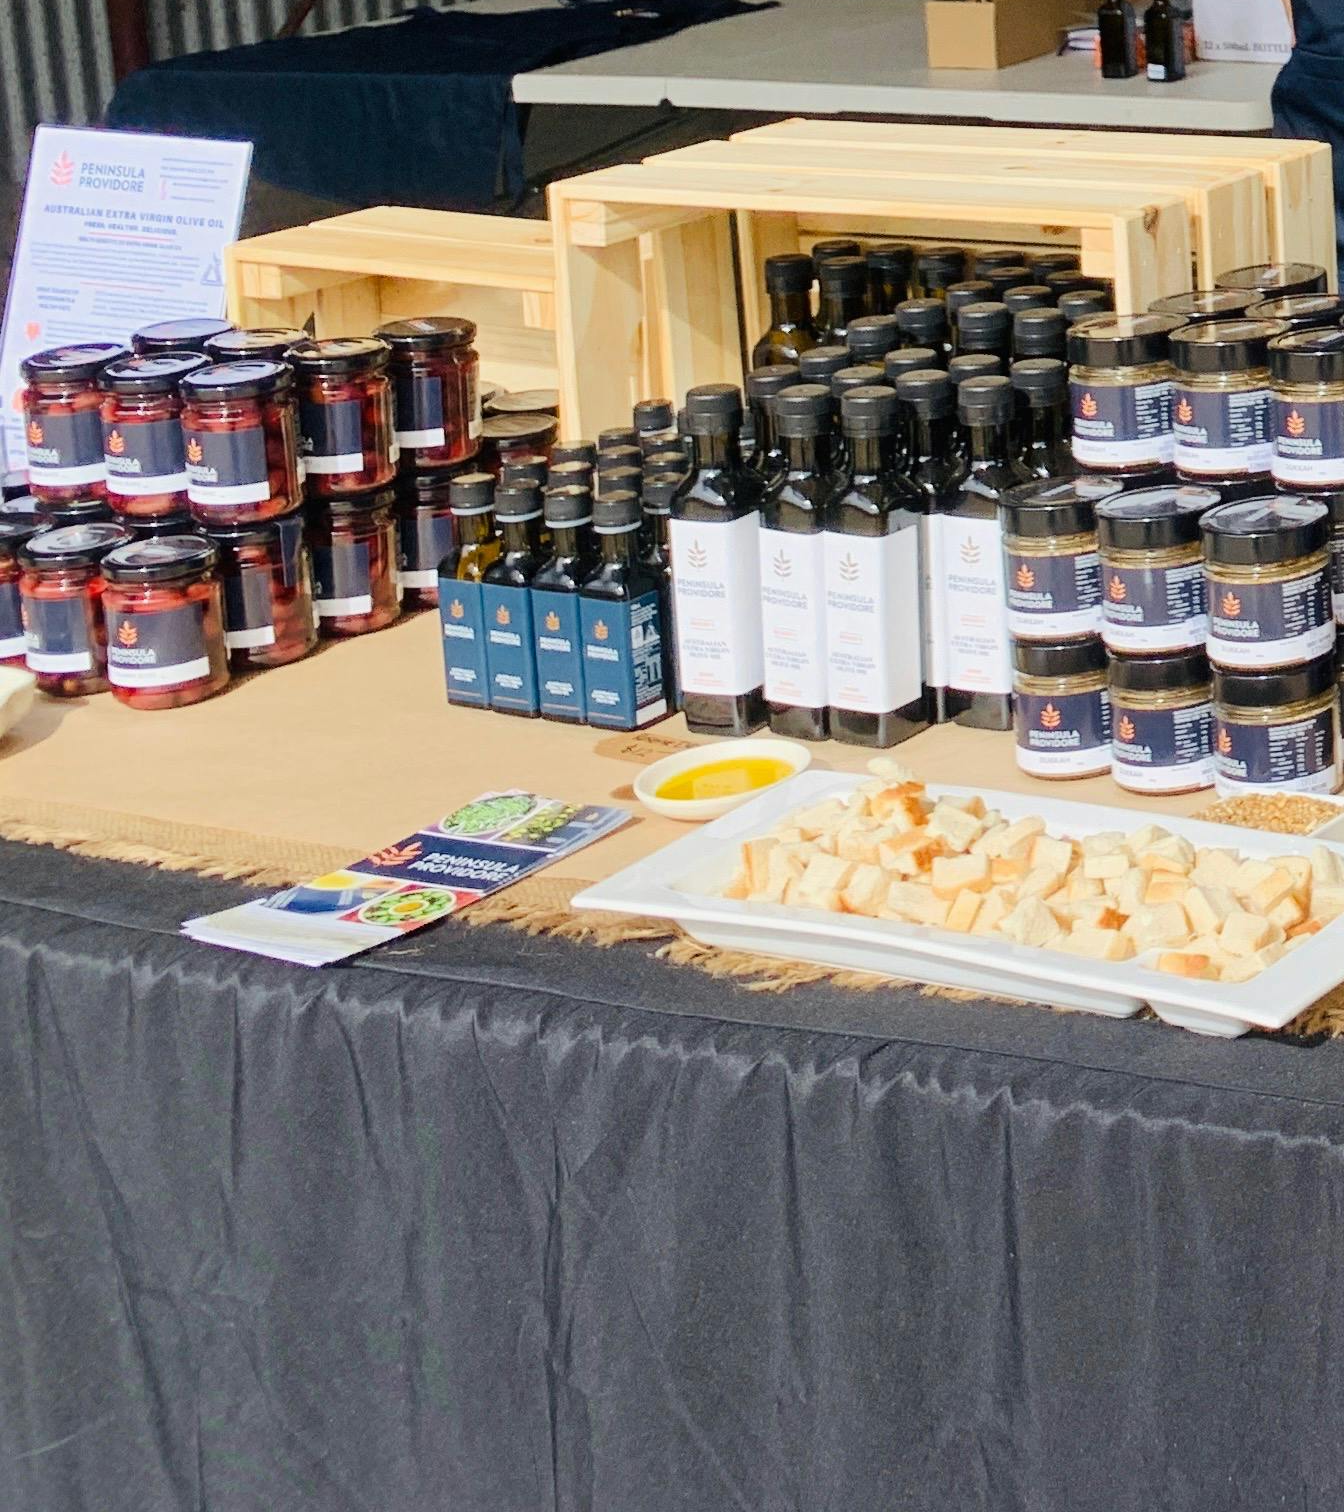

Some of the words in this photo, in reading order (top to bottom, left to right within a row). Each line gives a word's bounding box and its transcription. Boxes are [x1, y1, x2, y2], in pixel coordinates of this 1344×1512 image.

[81, 162, 145, 178] PENINSULA
[79, 176, 144, 193] PROVIDORE
[44, 204, 103, 217] AUSTRALIAN
[105, 210, 136, 220] EXTRA
[139, 213, 173, 223] VIRGIN
[176, 216, 204, 227] OLIVE
[208, 219, 224, 229] OIL
[678, 578, 725, 589] PENINSULA
[949, 575, 996, 585] PENINSULA
[677, 587, 725, 598] PROVIDORE
[762, 587, 807, 600] PENINSULA
[949, 583, 997, 595] PROVIDORE
[762, 595, 808, 609] PROVIDORE
[828, 590, 875, 604] PENINSULA
[827, 600, 875, 613] PROVIDORE
[422, 853, 519, 873] PENINSULA
[407, 860, 509, 881] PROVIDORE
